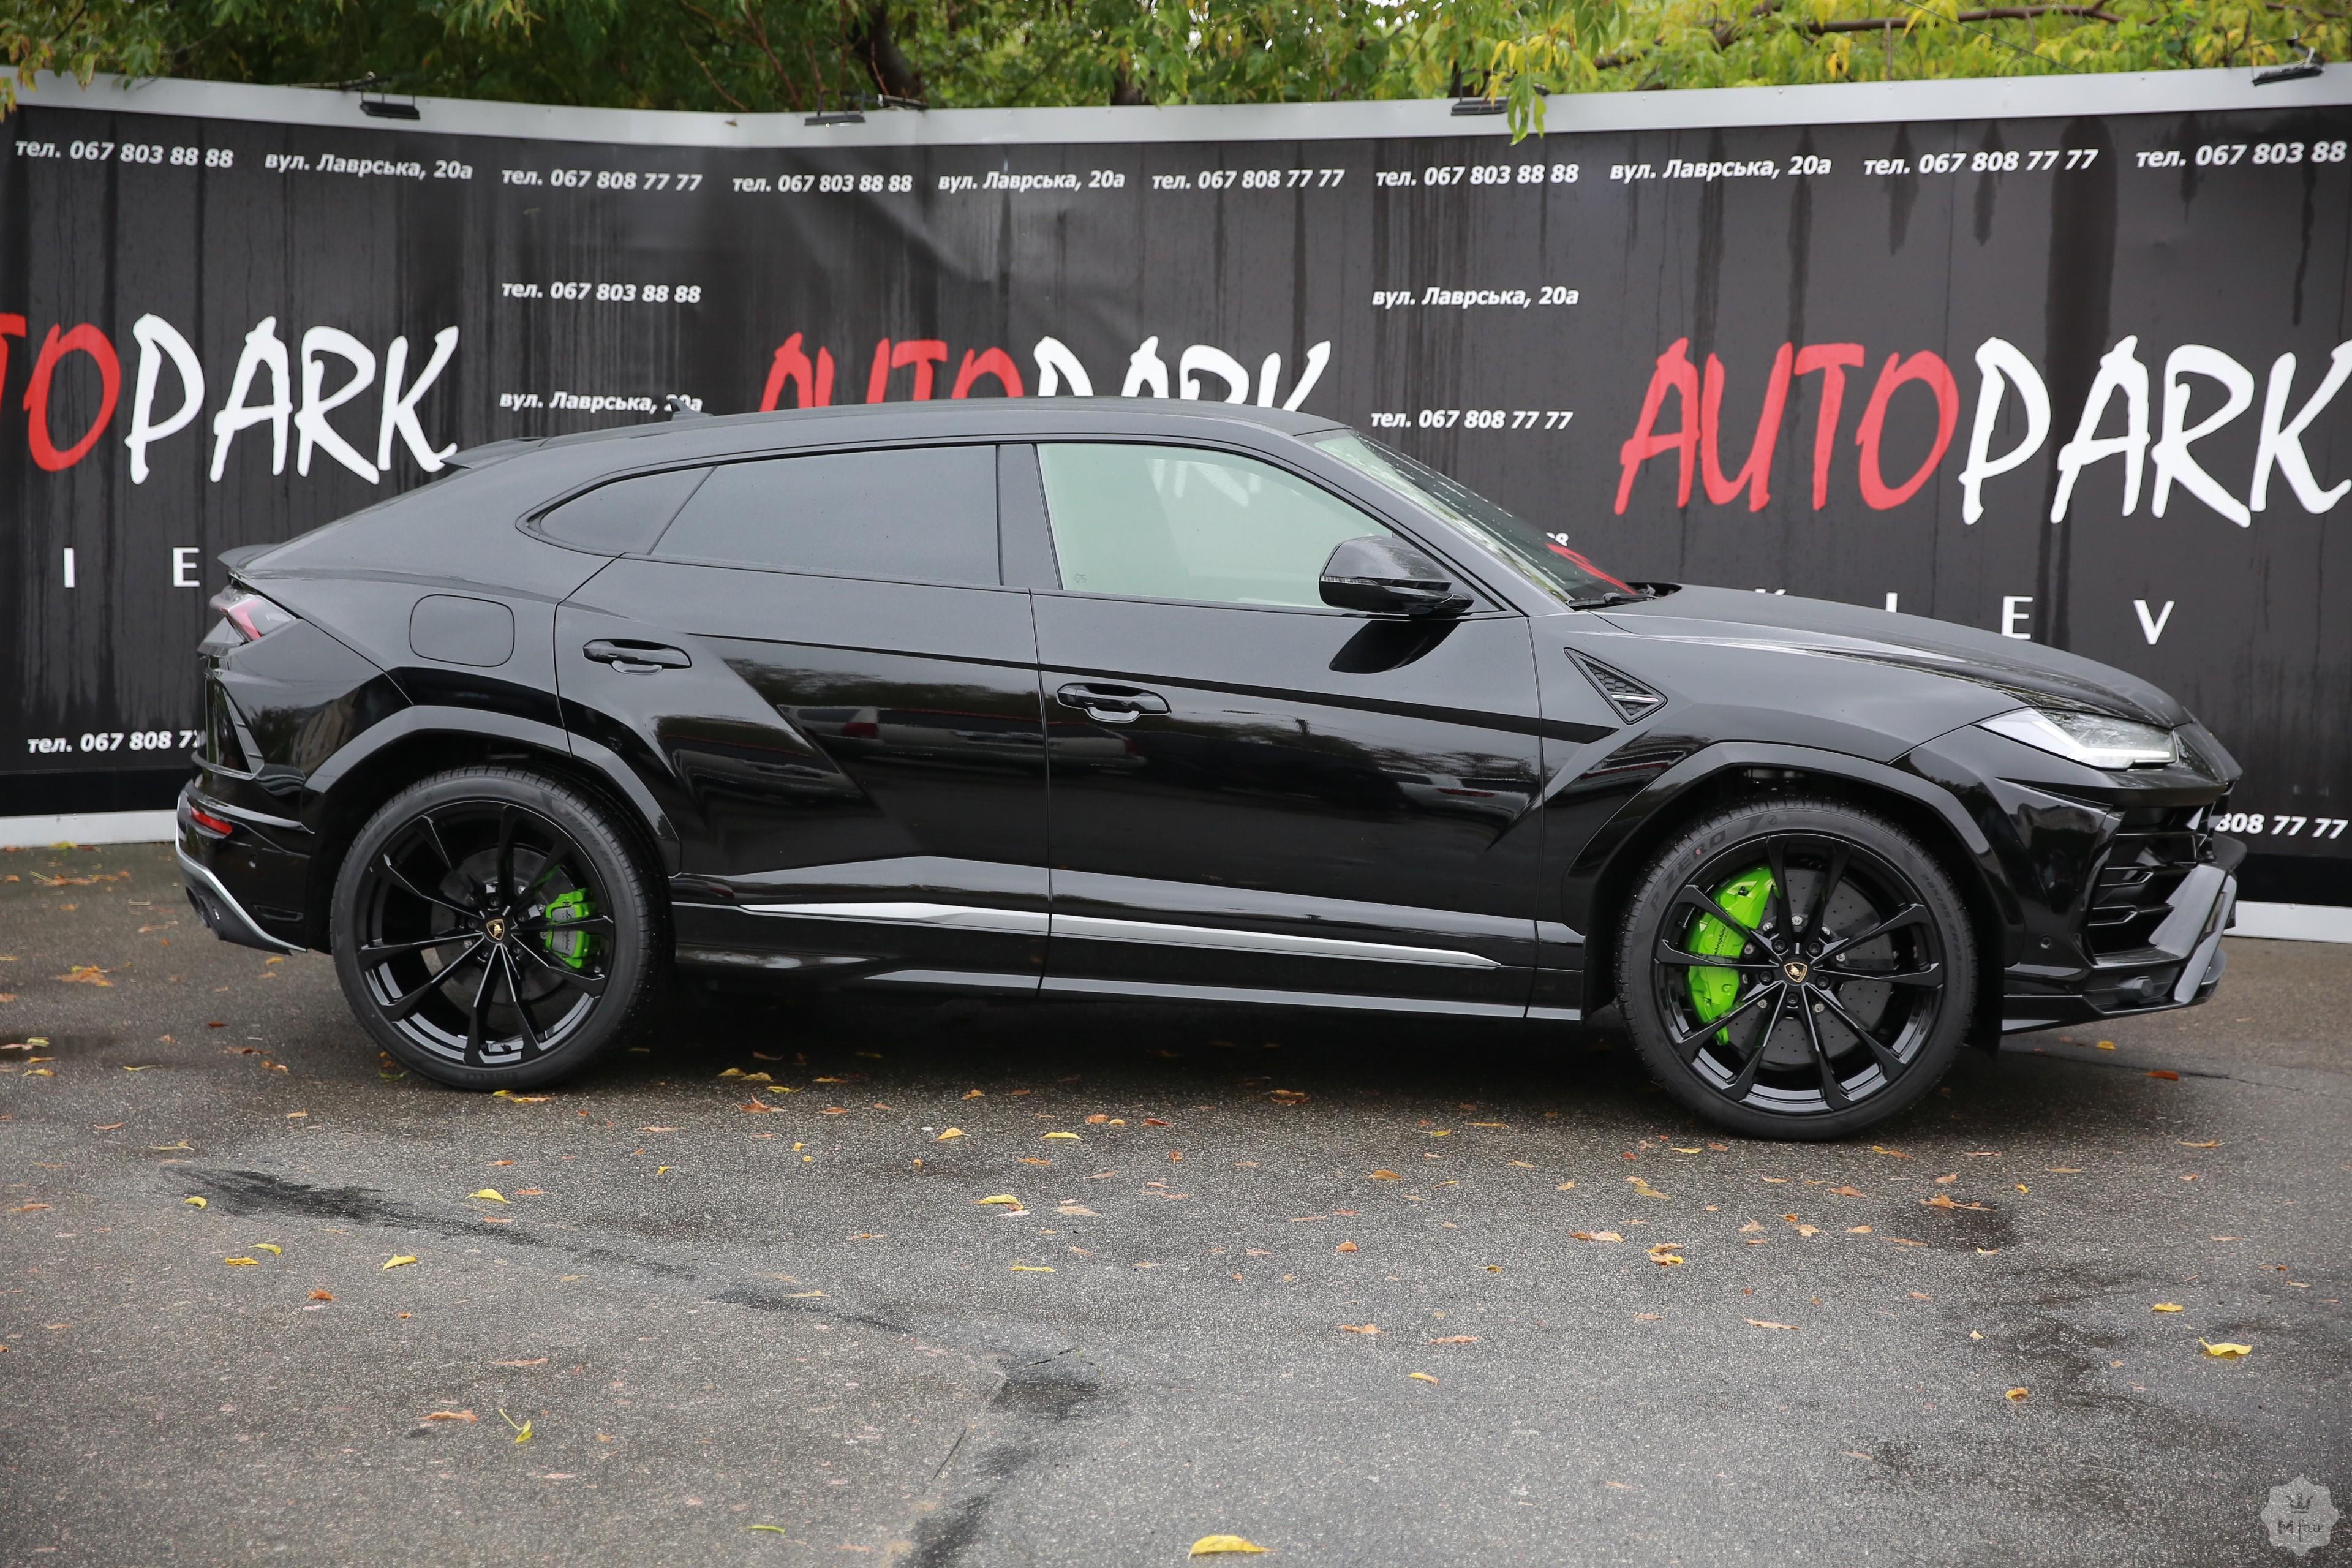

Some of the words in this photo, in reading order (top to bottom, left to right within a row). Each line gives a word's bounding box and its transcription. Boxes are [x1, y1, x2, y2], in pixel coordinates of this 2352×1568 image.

[16, 141, 61, 158] тел.
[70, 140, 115, 160] 067
[120, 143, 164, 164] 803
[170, 146, 199, 166] 88
[205, 148, 234, 168] 88
[1863, 159, 1910, 176] тел.
[1918, 153, 1967, 174] 067
[1970, 151, 2020, 173] 808
[2026, 150, 2060, 171] 77
[2065, 149, 2099, 170] 77
[2136, 150, 2187, 168] тел.
[2195, 144, 2247, 166] 067
[2252, 142, 2304, 165] 803
[2311, 141, 2347, 163] 88
[265, 154, 310, 173] вул.
[316, 154, 426, 180] Лаврська,
[433, 160, 473, 179] 20а
[1152, 175, 1191, 190] тел.
[1197, 170, 1238, 189] 067
[1241, 170, 1282, 189] 808
[1286, 169, 1314, 188] 77
[1318, 168, 1346, 187] 77
[1376, 171, 1417, 187] тел.
[1423, 166, 1466, 186] 067
[1469, 165, 1512, 185] 803
[1516, 164, 1545, 184] 88
[1550, 163, 1580, 184] 88
[1609, 164, 1657, 184] вул.
[1662, 159, 1781, 182] Лаврська,
[1787, 155, 1832, 175] 20а
[502, 170, 543, 186] тел.
[550, 168, 592, 187] 067
[596, 171, 638, 190] 808
[643, 173, 671, 190] 77
[676, 173, 703, 192] 77
[732, 177, 771, 192] тел.
[777, 174, 816, 193] 067
[818, 174, 855, 193] 803
[858, 174, 884, 192] 88
[888, 174, 913, 192] 88
[938, 175, 978, 194] вул.
[982, 171, 1082, 194] Лаврська,
[1087, 170, 1126, 189] 20а
[502, 283, 543, 298] тел.
[550, 281, 592, 300] 067
[595, 283, 638, 302] 803
[641, 284, 669, 303] 88
[674, 285, 702, 303] 88
[1371, 290, 1416, 310] вул.
[1420, 287, 1532, 310] Лаврська,
[1537, 285, 1580, 306] 20а
[499, 393, 543, 412] вул.
[548, 391, 658, 415] Лаврська,
[1370, 412, 1412, 428] тел.
[1418, 409, 1461, 429] 067
[1463, 410, 1507, 429] 808
[1510, 410, 1540, 429] 77
[1544, 410, 1574, 430] 77
[28, 737, 72, 753] тел.
[80, 732, 124, 752] 067
[129, 730, 173, 750] 808
[2271, 815, 2307, 836] 77
[2312, 818, 2349, 839] 77
